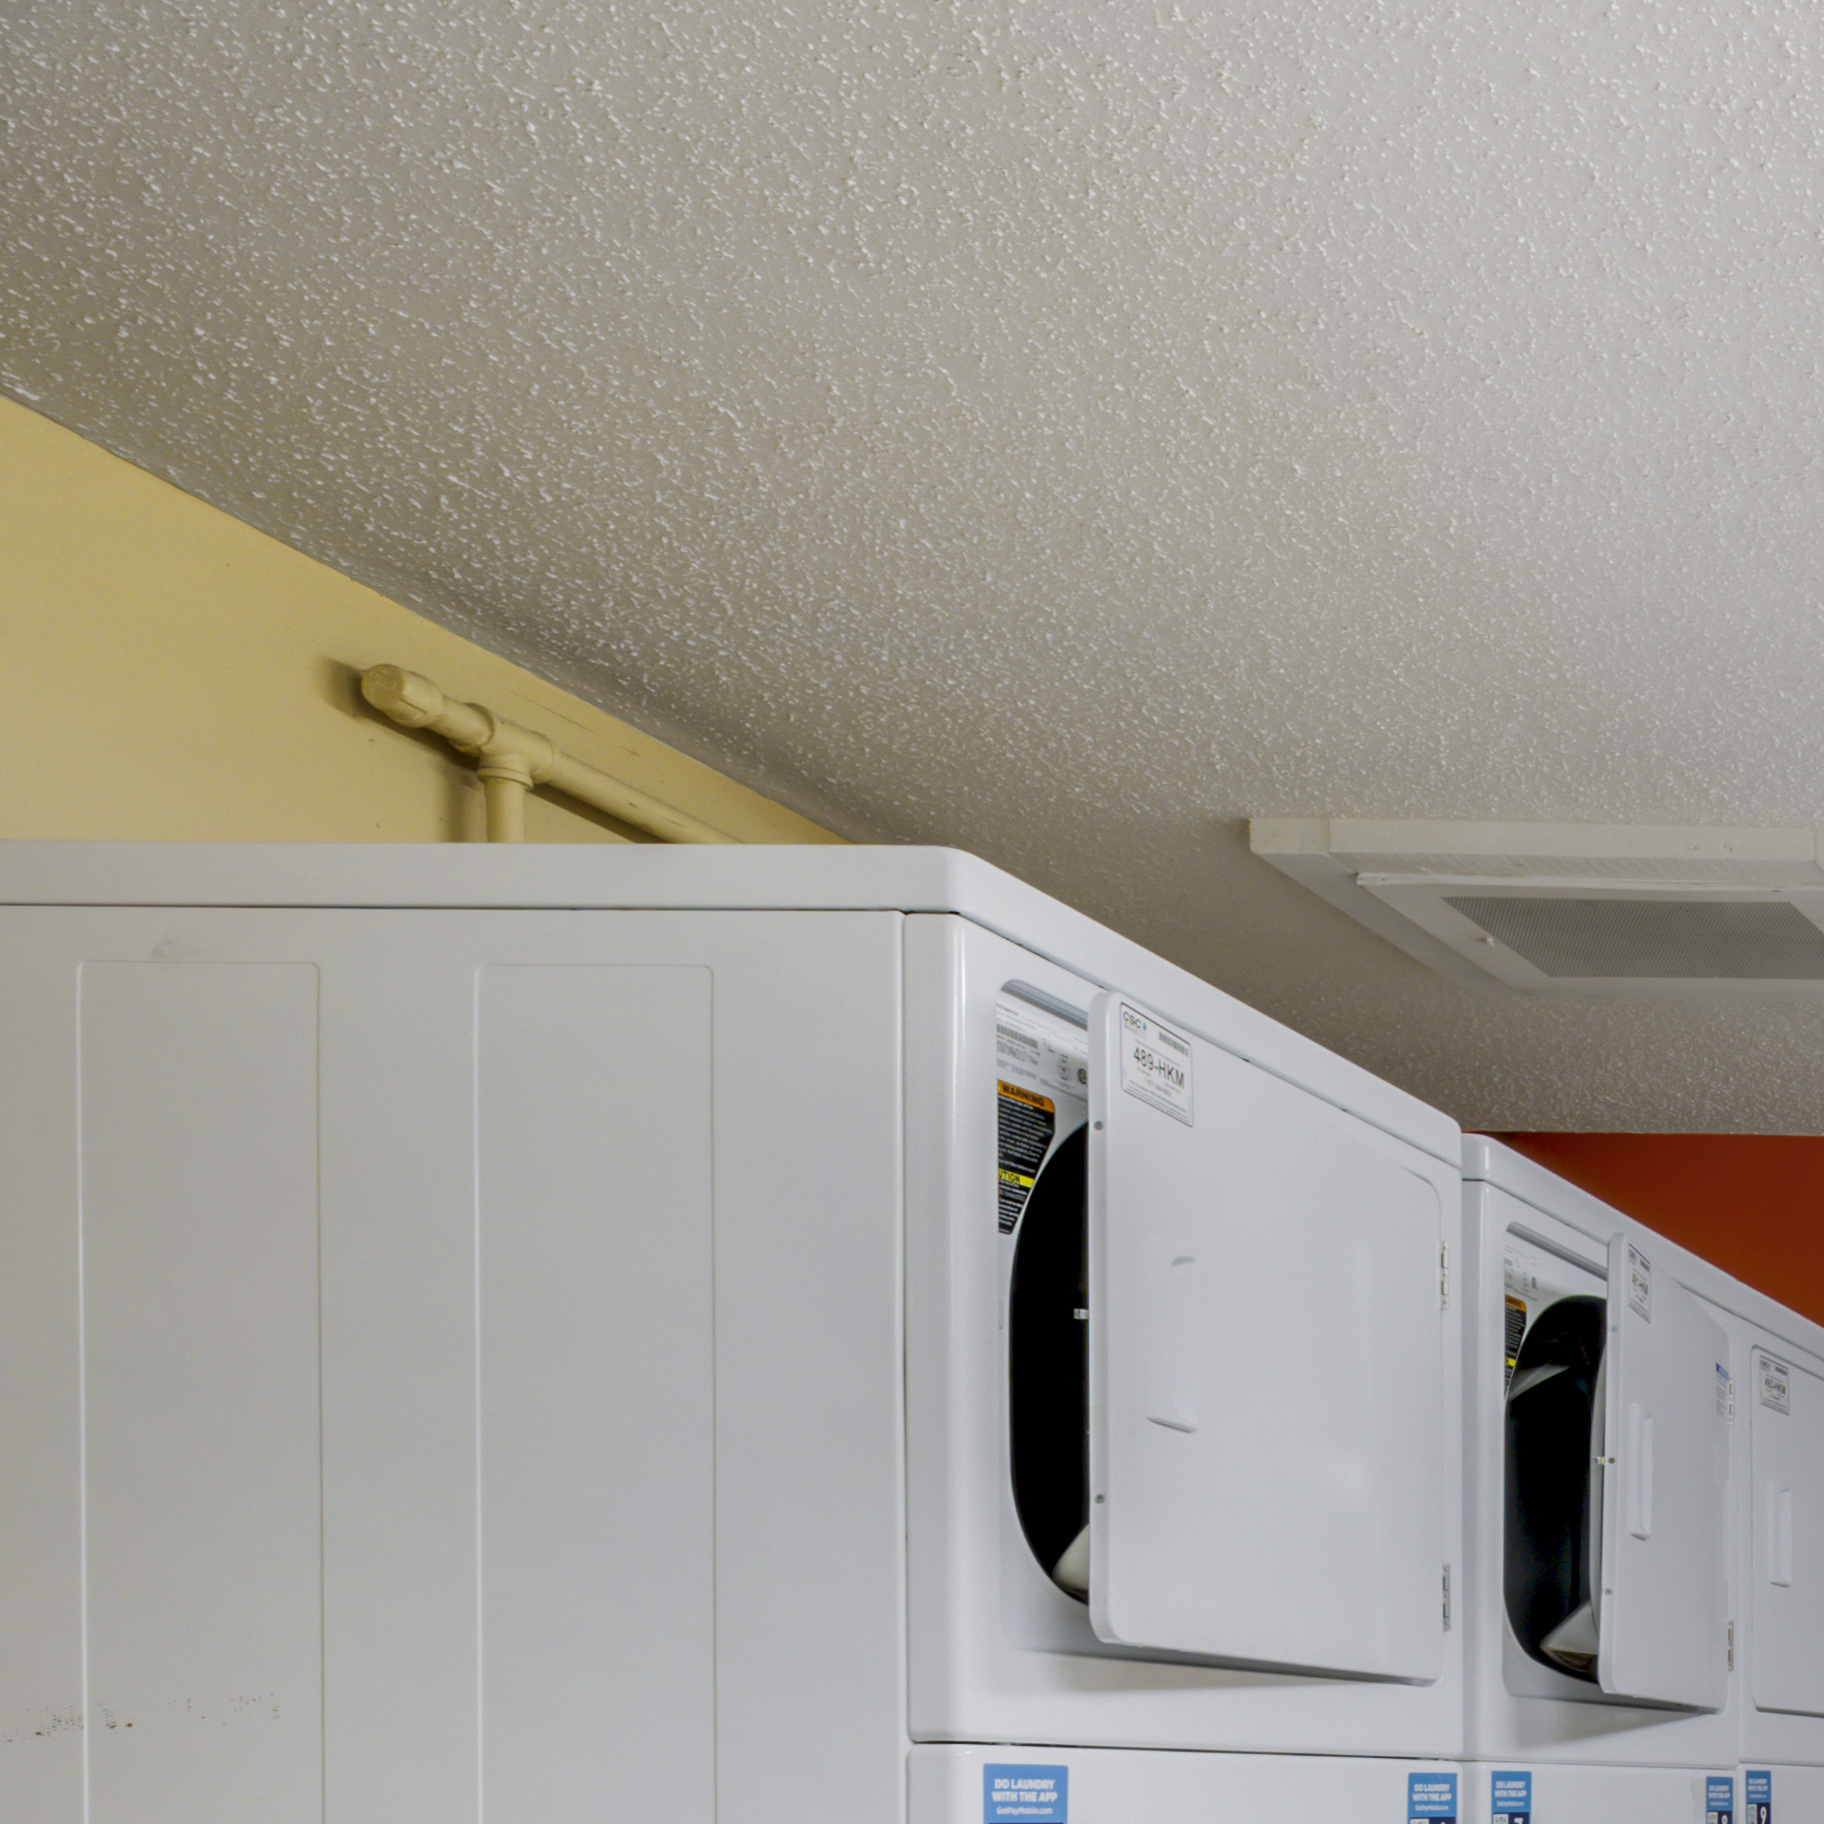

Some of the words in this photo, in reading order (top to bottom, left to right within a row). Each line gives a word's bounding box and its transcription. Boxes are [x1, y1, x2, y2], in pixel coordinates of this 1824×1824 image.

[1133, 1047, 1185, 1088] 489-HKM
[1002, 1083, 1045, 1107] WARNING
[994, 1779, 1010, 1789] DO
[1011, 1779, 1055, 1790] LAUNDRY
[992, 1791, 1017, 1802] WITH
[1019, 1791, 1037, 1802] THE
[1038, 1791, 1058, 1802] APP
